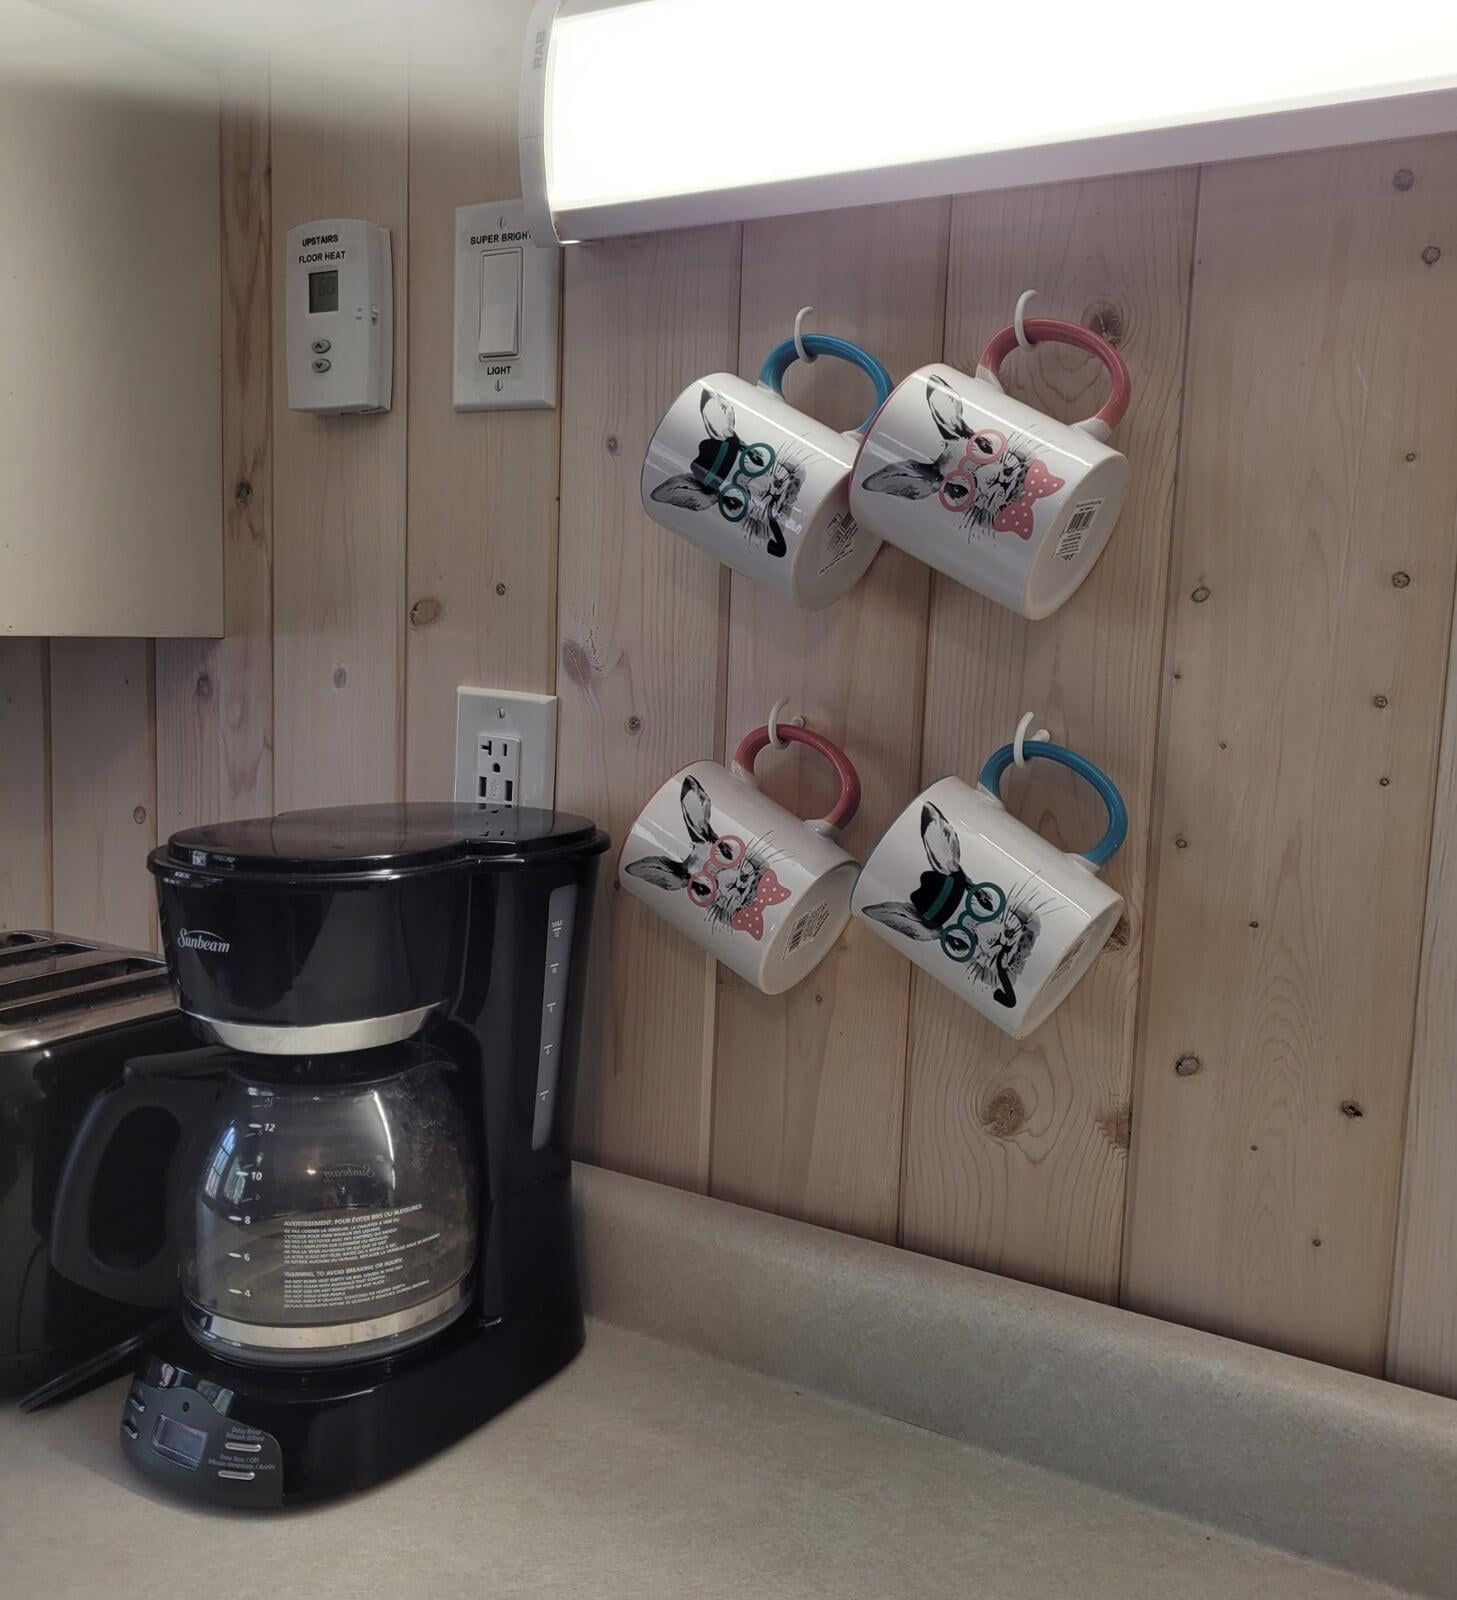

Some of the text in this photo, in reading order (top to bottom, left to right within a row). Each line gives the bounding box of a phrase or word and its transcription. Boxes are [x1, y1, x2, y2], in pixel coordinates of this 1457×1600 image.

[533, 31, 545, 69] RAB
[302, 234, 339, 247] UPSTAIRS
[470, 234, 500, 245] SUPER
[298, 250, 346, 264] FLOOR HEAT
[487, 365, 512, 375] LIGHT
[177, 928, 231, 953] Sunbeam
[264, 1123, 276, 1132] 12
[250, 1171, 263, 1181] 10
[244, 1215, 251, 1225] 8
[243, 1253, 250, 1261] 6
